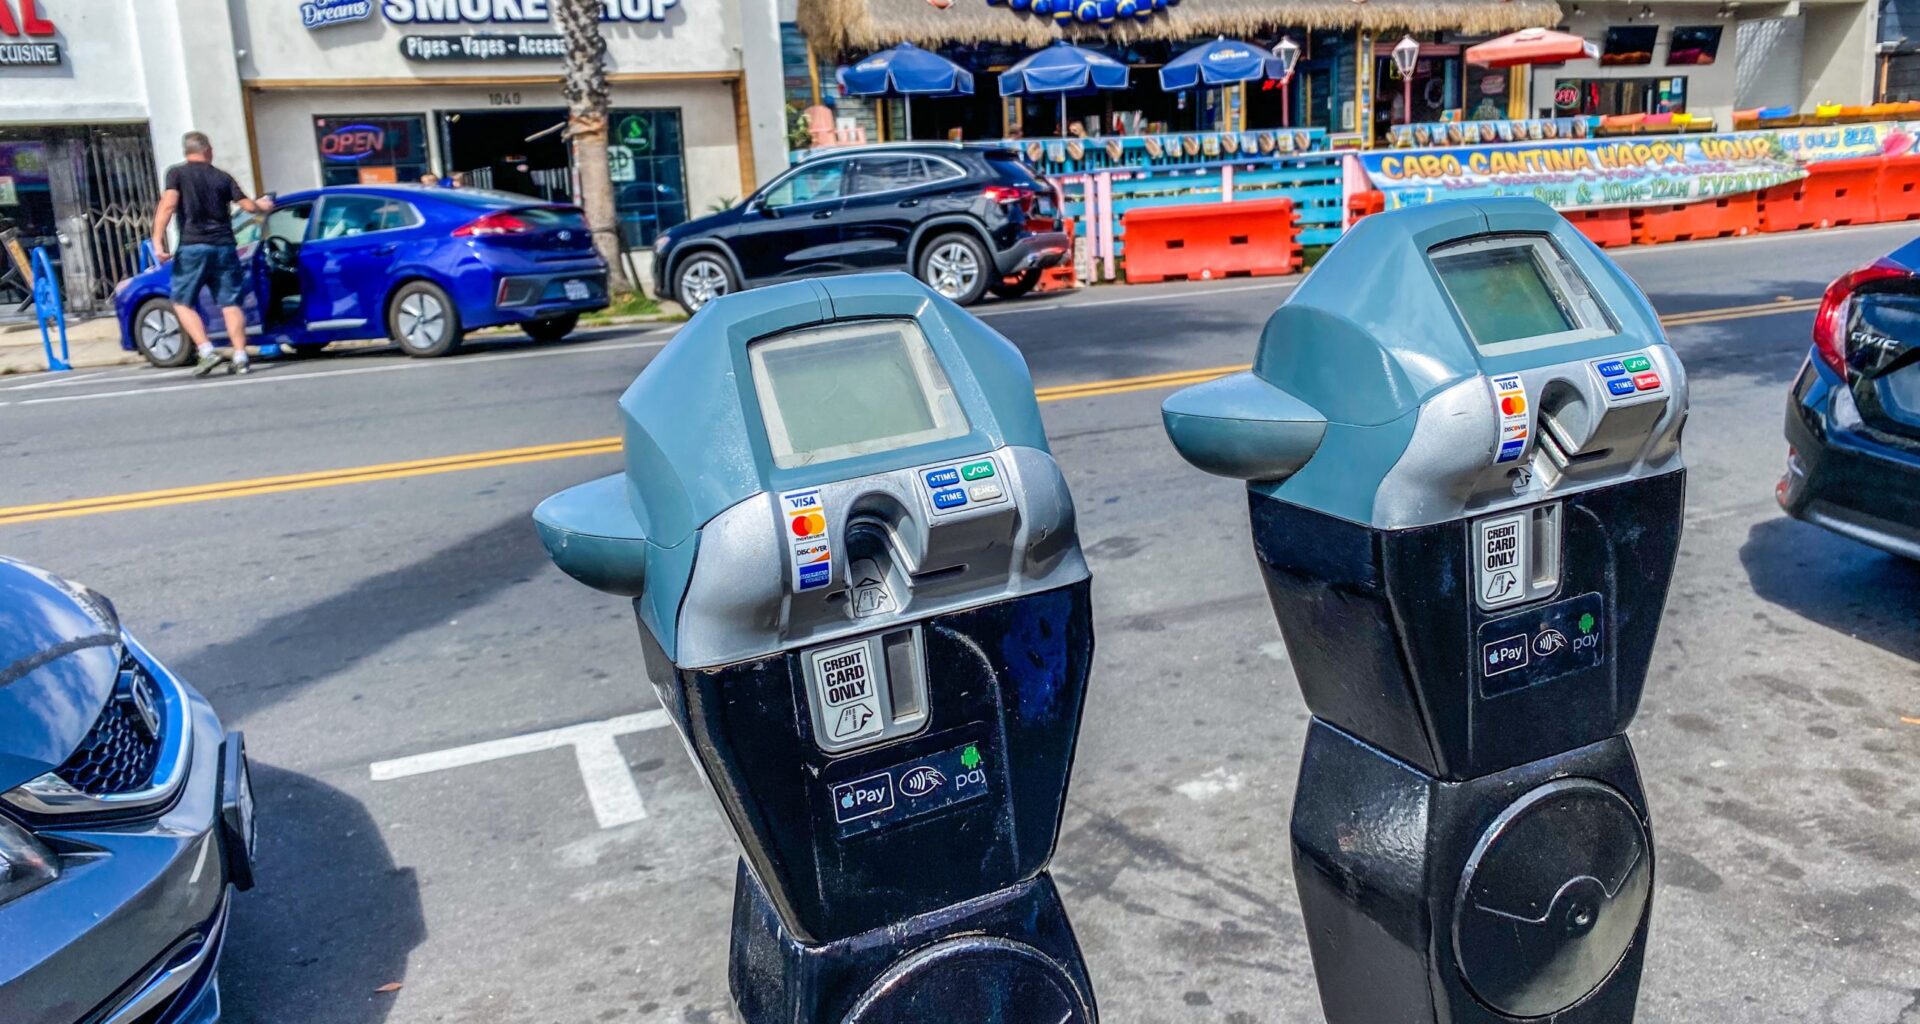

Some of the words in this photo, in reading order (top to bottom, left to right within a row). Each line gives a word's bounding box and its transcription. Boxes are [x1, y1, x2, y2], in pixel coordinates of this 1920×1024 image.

[302, 1, 366, 24] Dreams
[0, 45, 57, 61] CUISINE
[406, 36, 450, 59] Pipes
[461, 36, 506, 59] Vapes
[518, 35, 567, 55] Access
[489, 92, 521, 105] 1040
[1555, 86, 1577, 103] OPEN
[321, 131, 385, 154] OPEN
[1381, 154, 1463, 180] CABO
[1468, 147, 1594, 176] CANTINA
[1597, 140, 1685, 168] HAPPY
[1701, 137, 1772, 161] HOUR
[1576, 182, 1592, 203] &
[1851, 331, 1900, 350] CIVIC
[1499, 381, 1519, 391] VISA
[930, 471, 957, 482] +TIME
[976, 465, 990, 473] OK
[791, 496, 817, 508] VISA
[938, 491, 963, 502] -TIME
[1487, 525, 1516, 541] CREDIT
[796, 545, 828, 556] DISCOVER
[1487, 536, 1516, 554] CARD
[1487, 549, 1516, 569] ONLY
[1500, 646, 1523, 662] Pay
[1573, 632, 1600, 653] pay
[823, 652, 861, 673] CREDIT
[825, 664, 865, 688] CARD
[828, 679, 866, 704] ONLY
[855, 786, 886, 806] Pay
